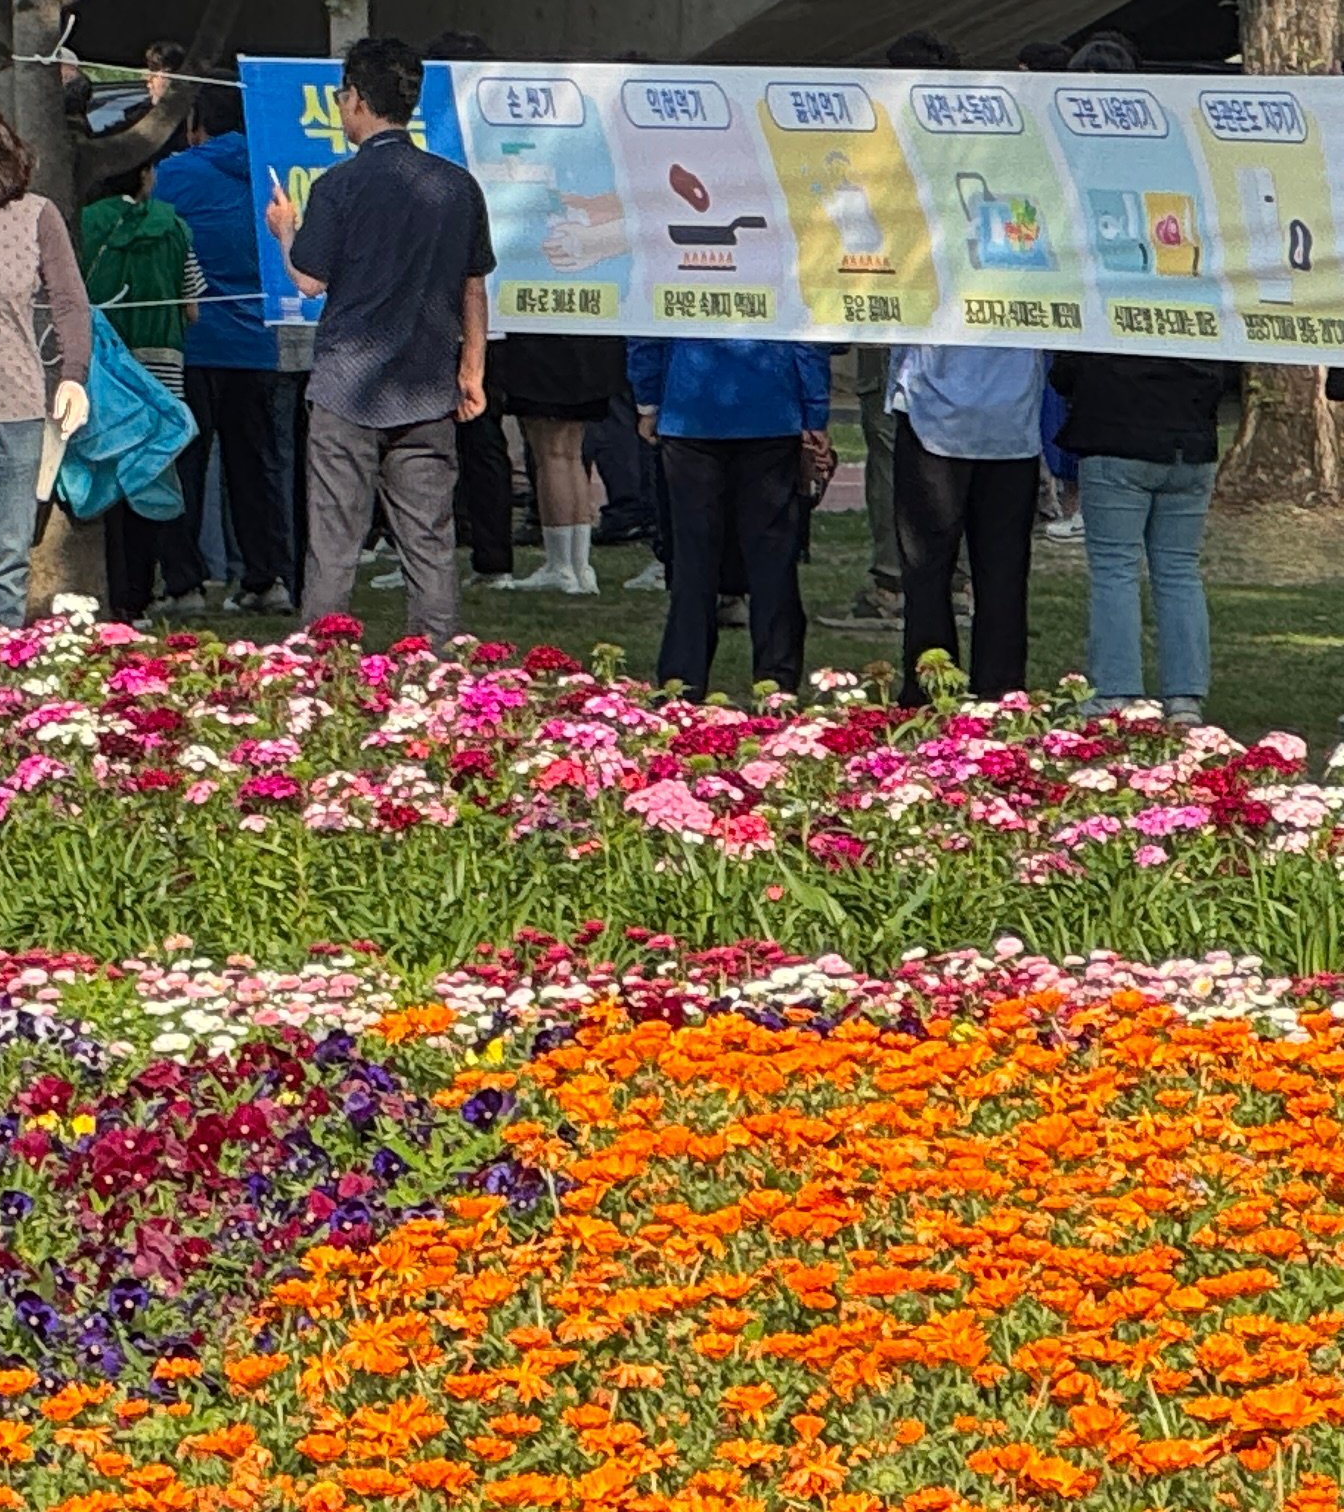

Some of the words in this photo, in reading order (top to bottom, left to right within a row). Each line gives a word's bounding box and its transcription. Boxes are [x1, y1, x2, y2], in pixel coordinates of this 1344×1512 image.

[506, 86, 523, 119] 손
[526, 87, 558, 120] 씻기
[646, 88, 707, 121] 익혀먹기
[790, 91, 853, 124] 끓여먹기
[1067, 97, 1103, 129] 구분
